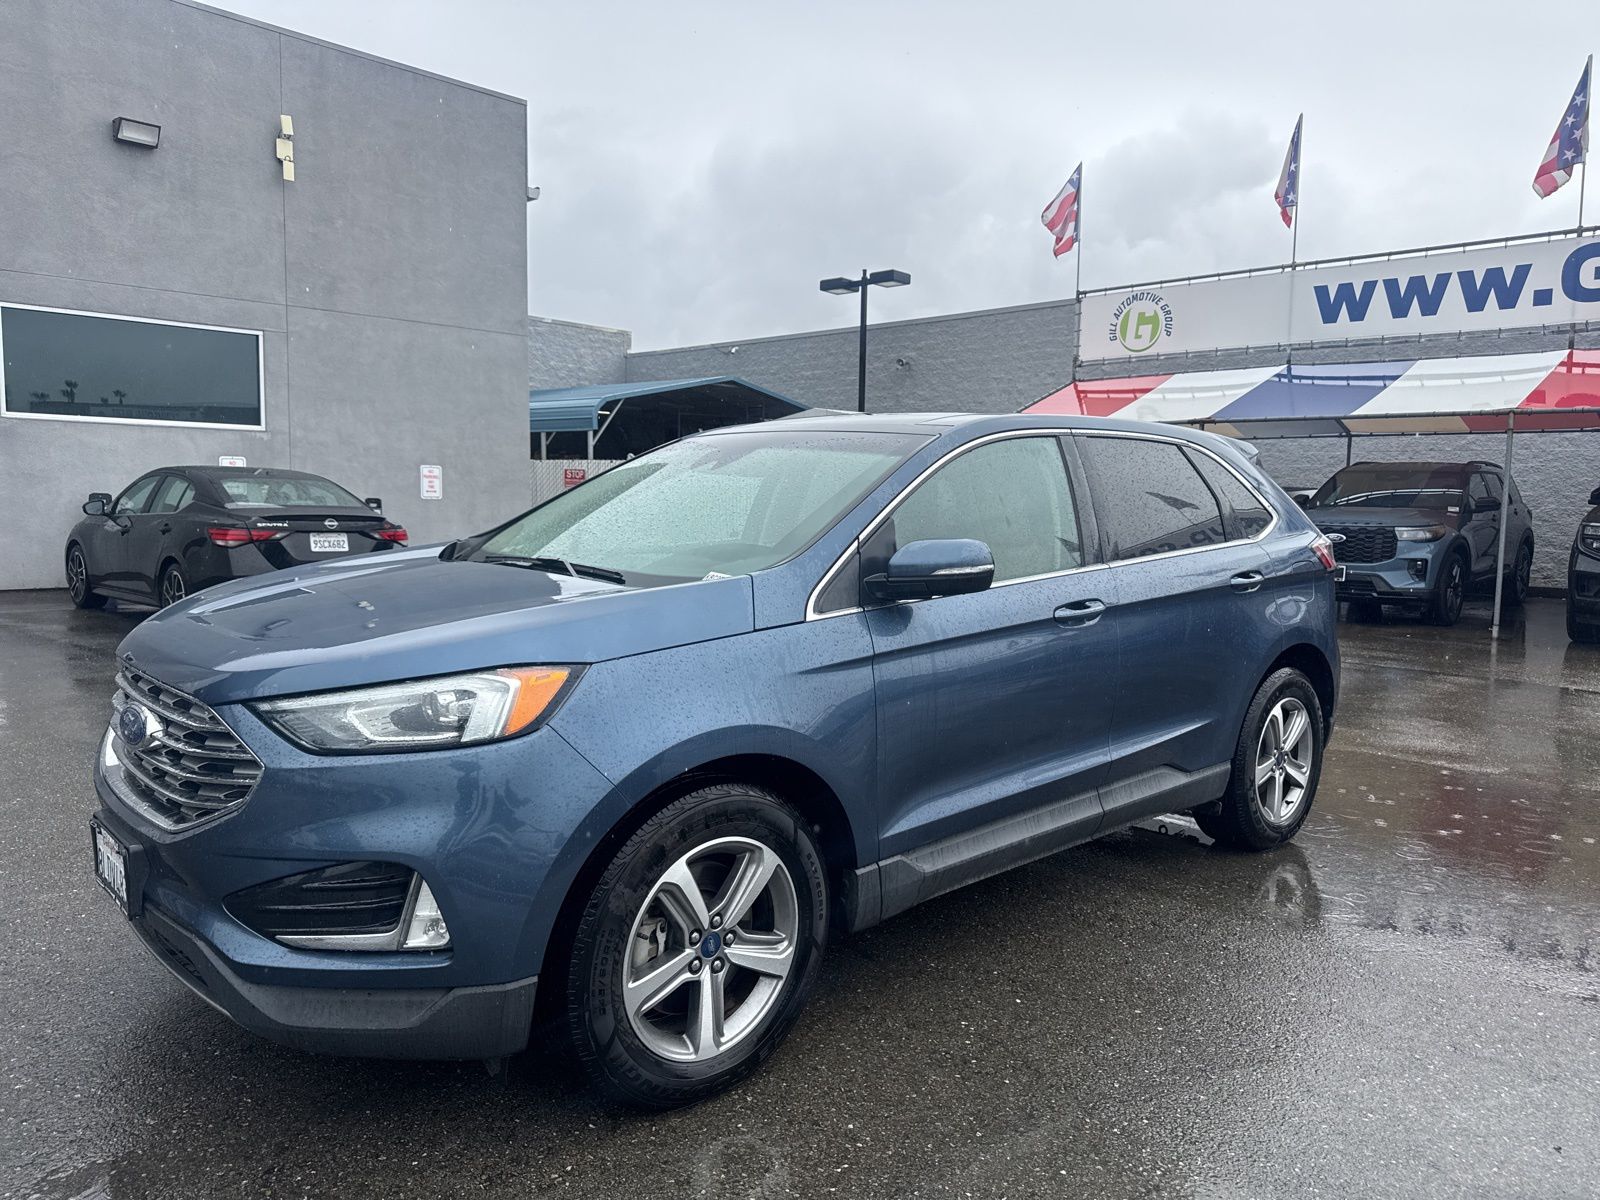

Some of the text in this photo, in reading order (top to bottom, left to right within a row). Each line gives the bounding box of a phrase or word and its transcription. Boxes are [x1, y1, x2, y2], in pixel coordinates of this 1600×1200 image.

[1109, 292, 1173, 341] GILL AUTOMOTIVE GROUP
[566, 470, 585, 479] STOP
